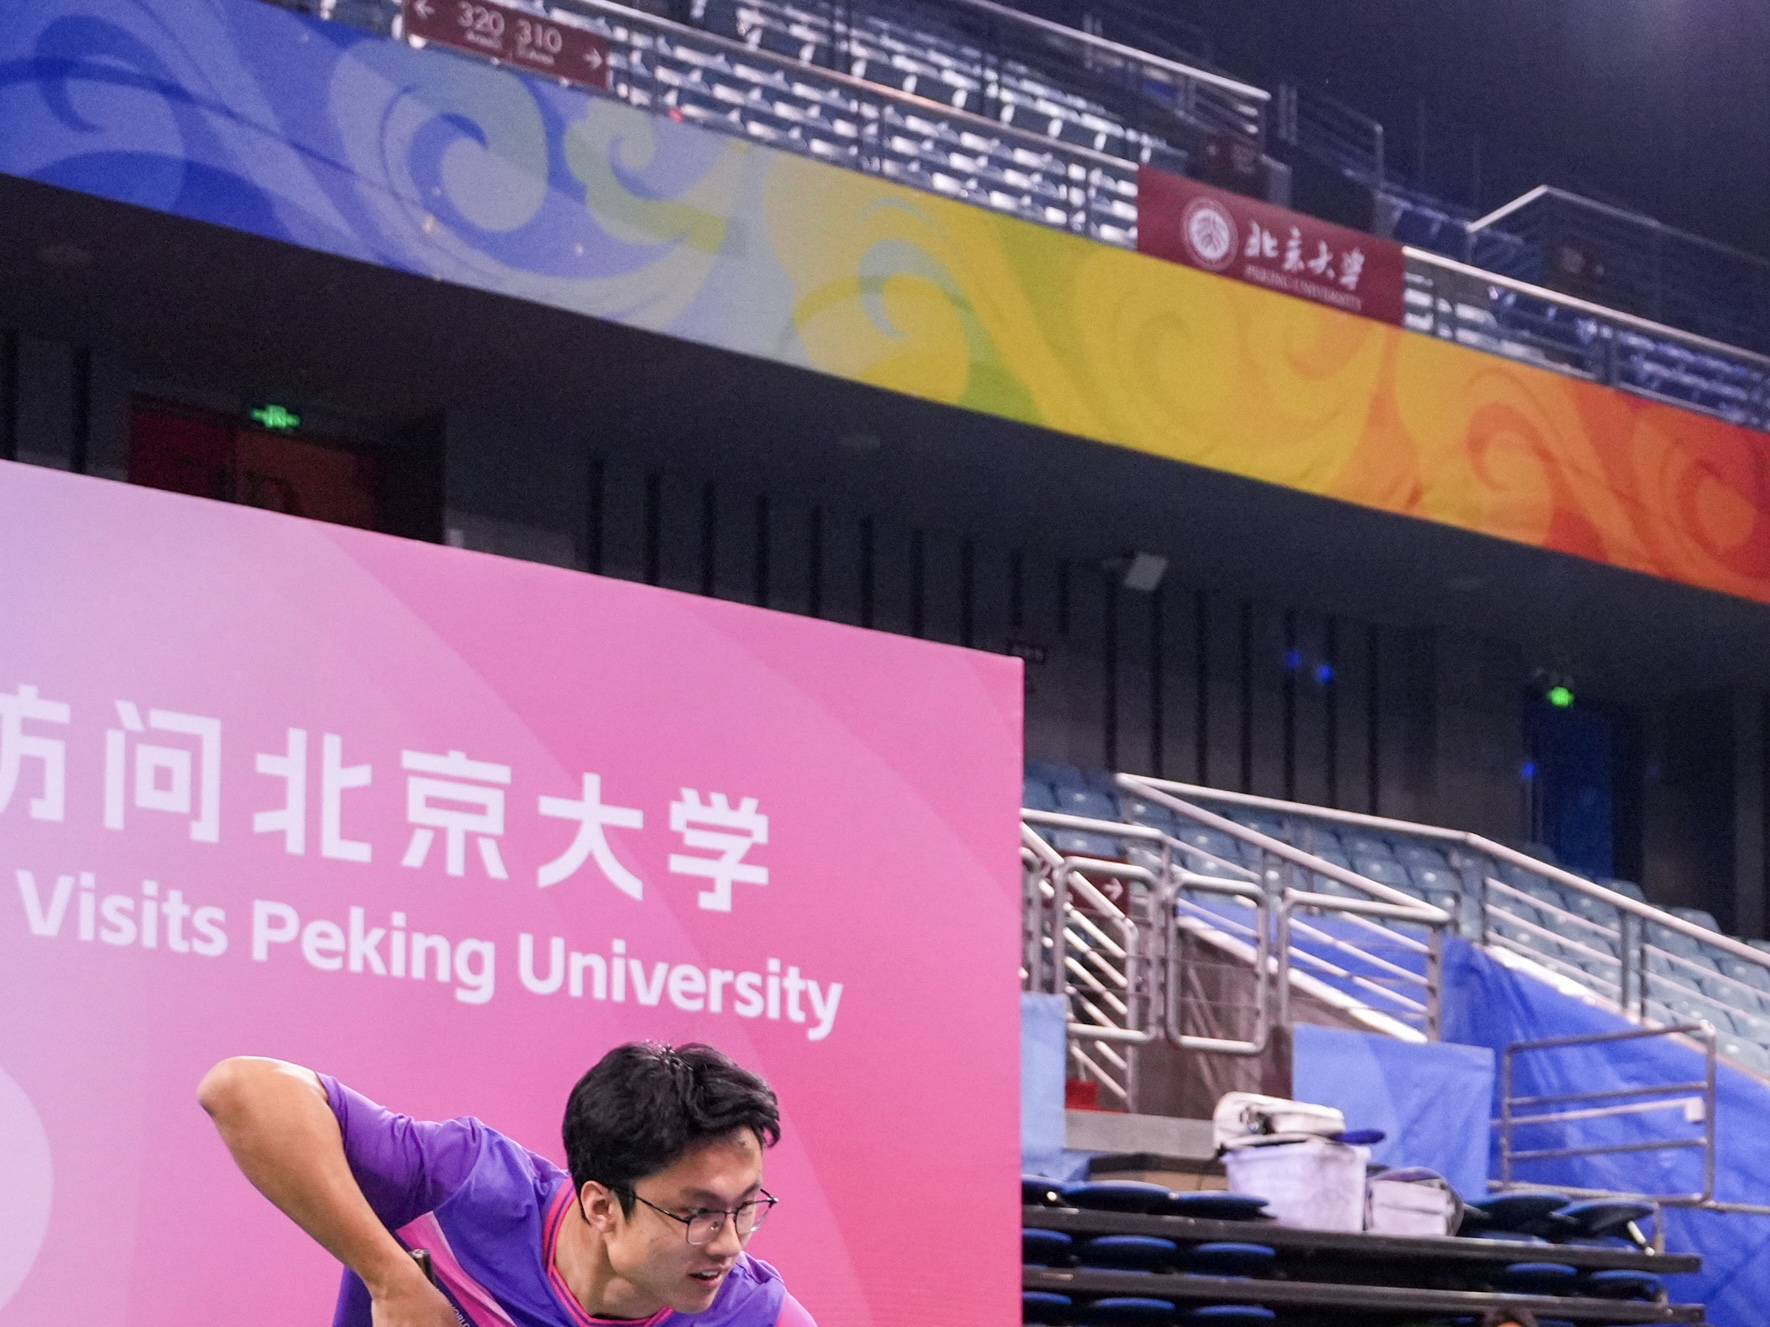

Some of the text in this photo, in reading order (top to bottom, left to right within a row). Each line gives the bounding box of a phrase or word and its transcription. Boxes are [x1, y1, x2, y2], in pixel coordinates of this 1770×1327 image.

[458, 2, 505, 37] 320
[515, 18, 562, 55] 310
[16, 868, 844, 1041] Visits Peking University
